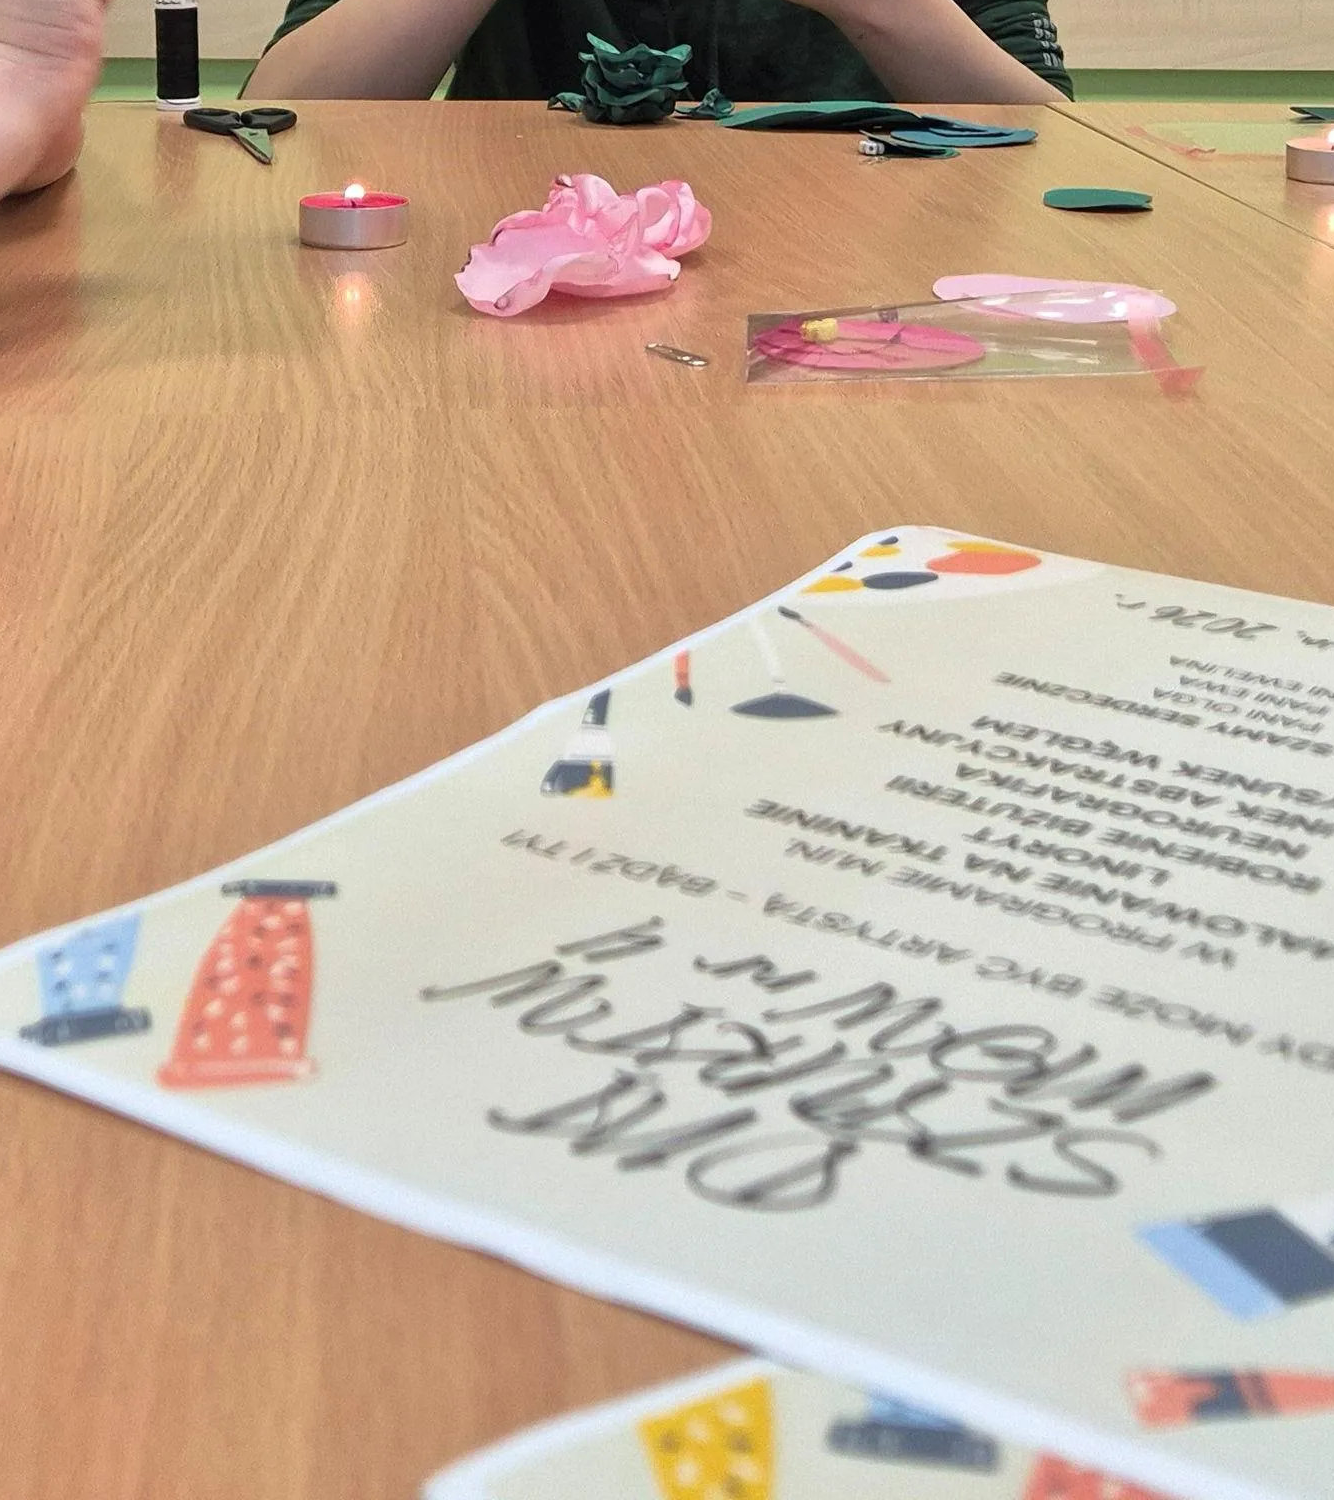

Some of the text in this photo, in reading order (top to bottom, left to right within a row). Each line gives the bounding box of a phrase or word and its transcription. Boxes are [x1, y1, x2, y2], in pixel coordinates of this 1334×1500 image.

[1148, 604, 1281, 641] 2026
[991, 671, 1202, 727] SERDECZNIE
[1168, 654, 1304, 693] EWELINA
[1179, 675, 1333, 716] PANI EWA
[1153, 687, 1326, 735] PANI OLGA
[875, 718, 1227, 809] ABSTRAKCYJNY
[970, 714, 1163, 770] WĘGLEM
[744, 798, 949, 863] TKANINIE
[954, 761, 1310, 861] NEUROGRAFIKA
[963, 825, 1173, 888] LINORYT
[963, 852, 1035, 885] NA
[1100, 826, 1324, 896] ROBIENIE
[886, 866, 1176, 953] PROGRAMIE
[1179, 941, 1240, 970] W
[1091, 985, 1255, 1046] MOŻE
